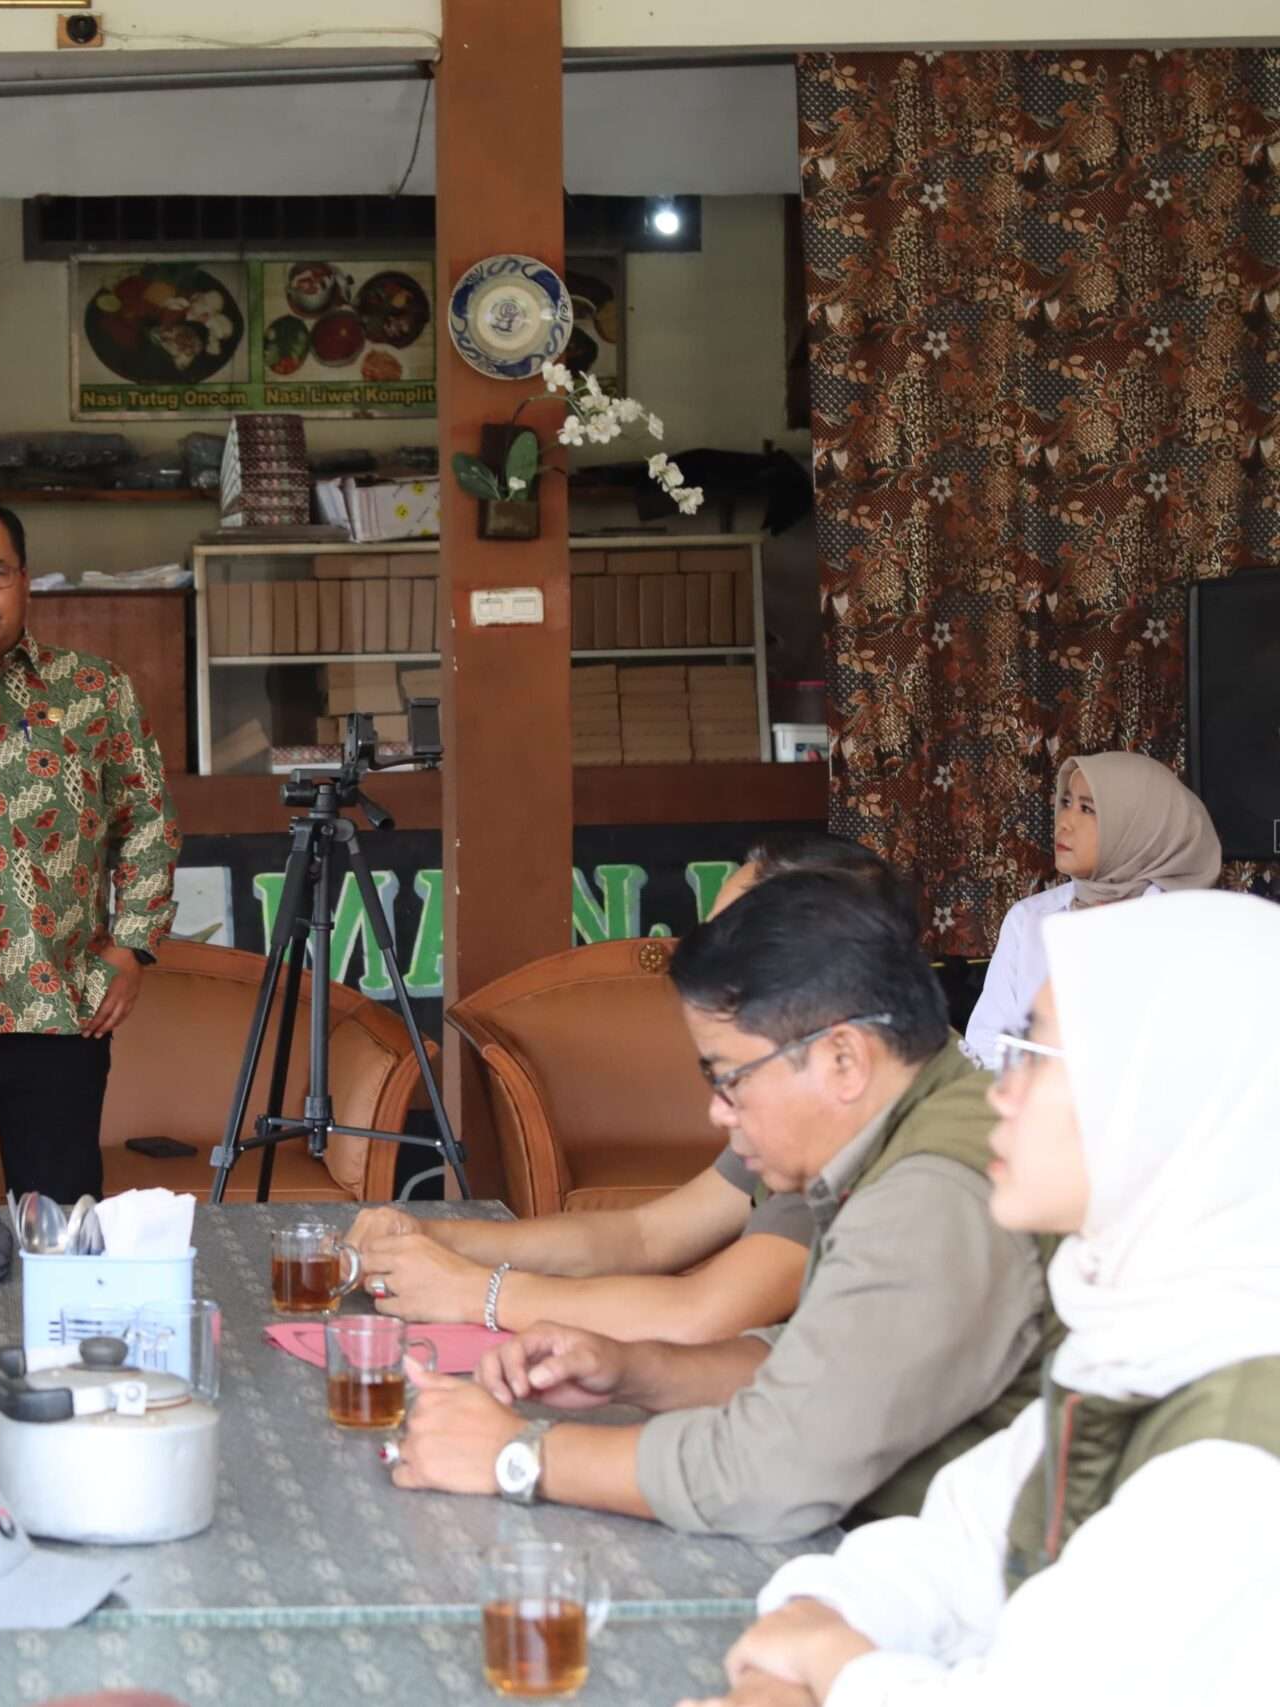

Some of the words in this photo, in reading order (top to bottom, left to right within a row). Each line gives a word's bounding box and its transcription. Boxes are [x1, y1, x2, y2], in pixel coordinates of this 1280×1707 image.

[82, 390, 121, 407] Nasi
[127, 390, 179, 410] Tutug
[183, 389, 249, 407] Oncom
[265, 387, 305, 404] Nasi
[311, 386, 361, 403] Liwet
[366, 384, 435, 405] Komplit
